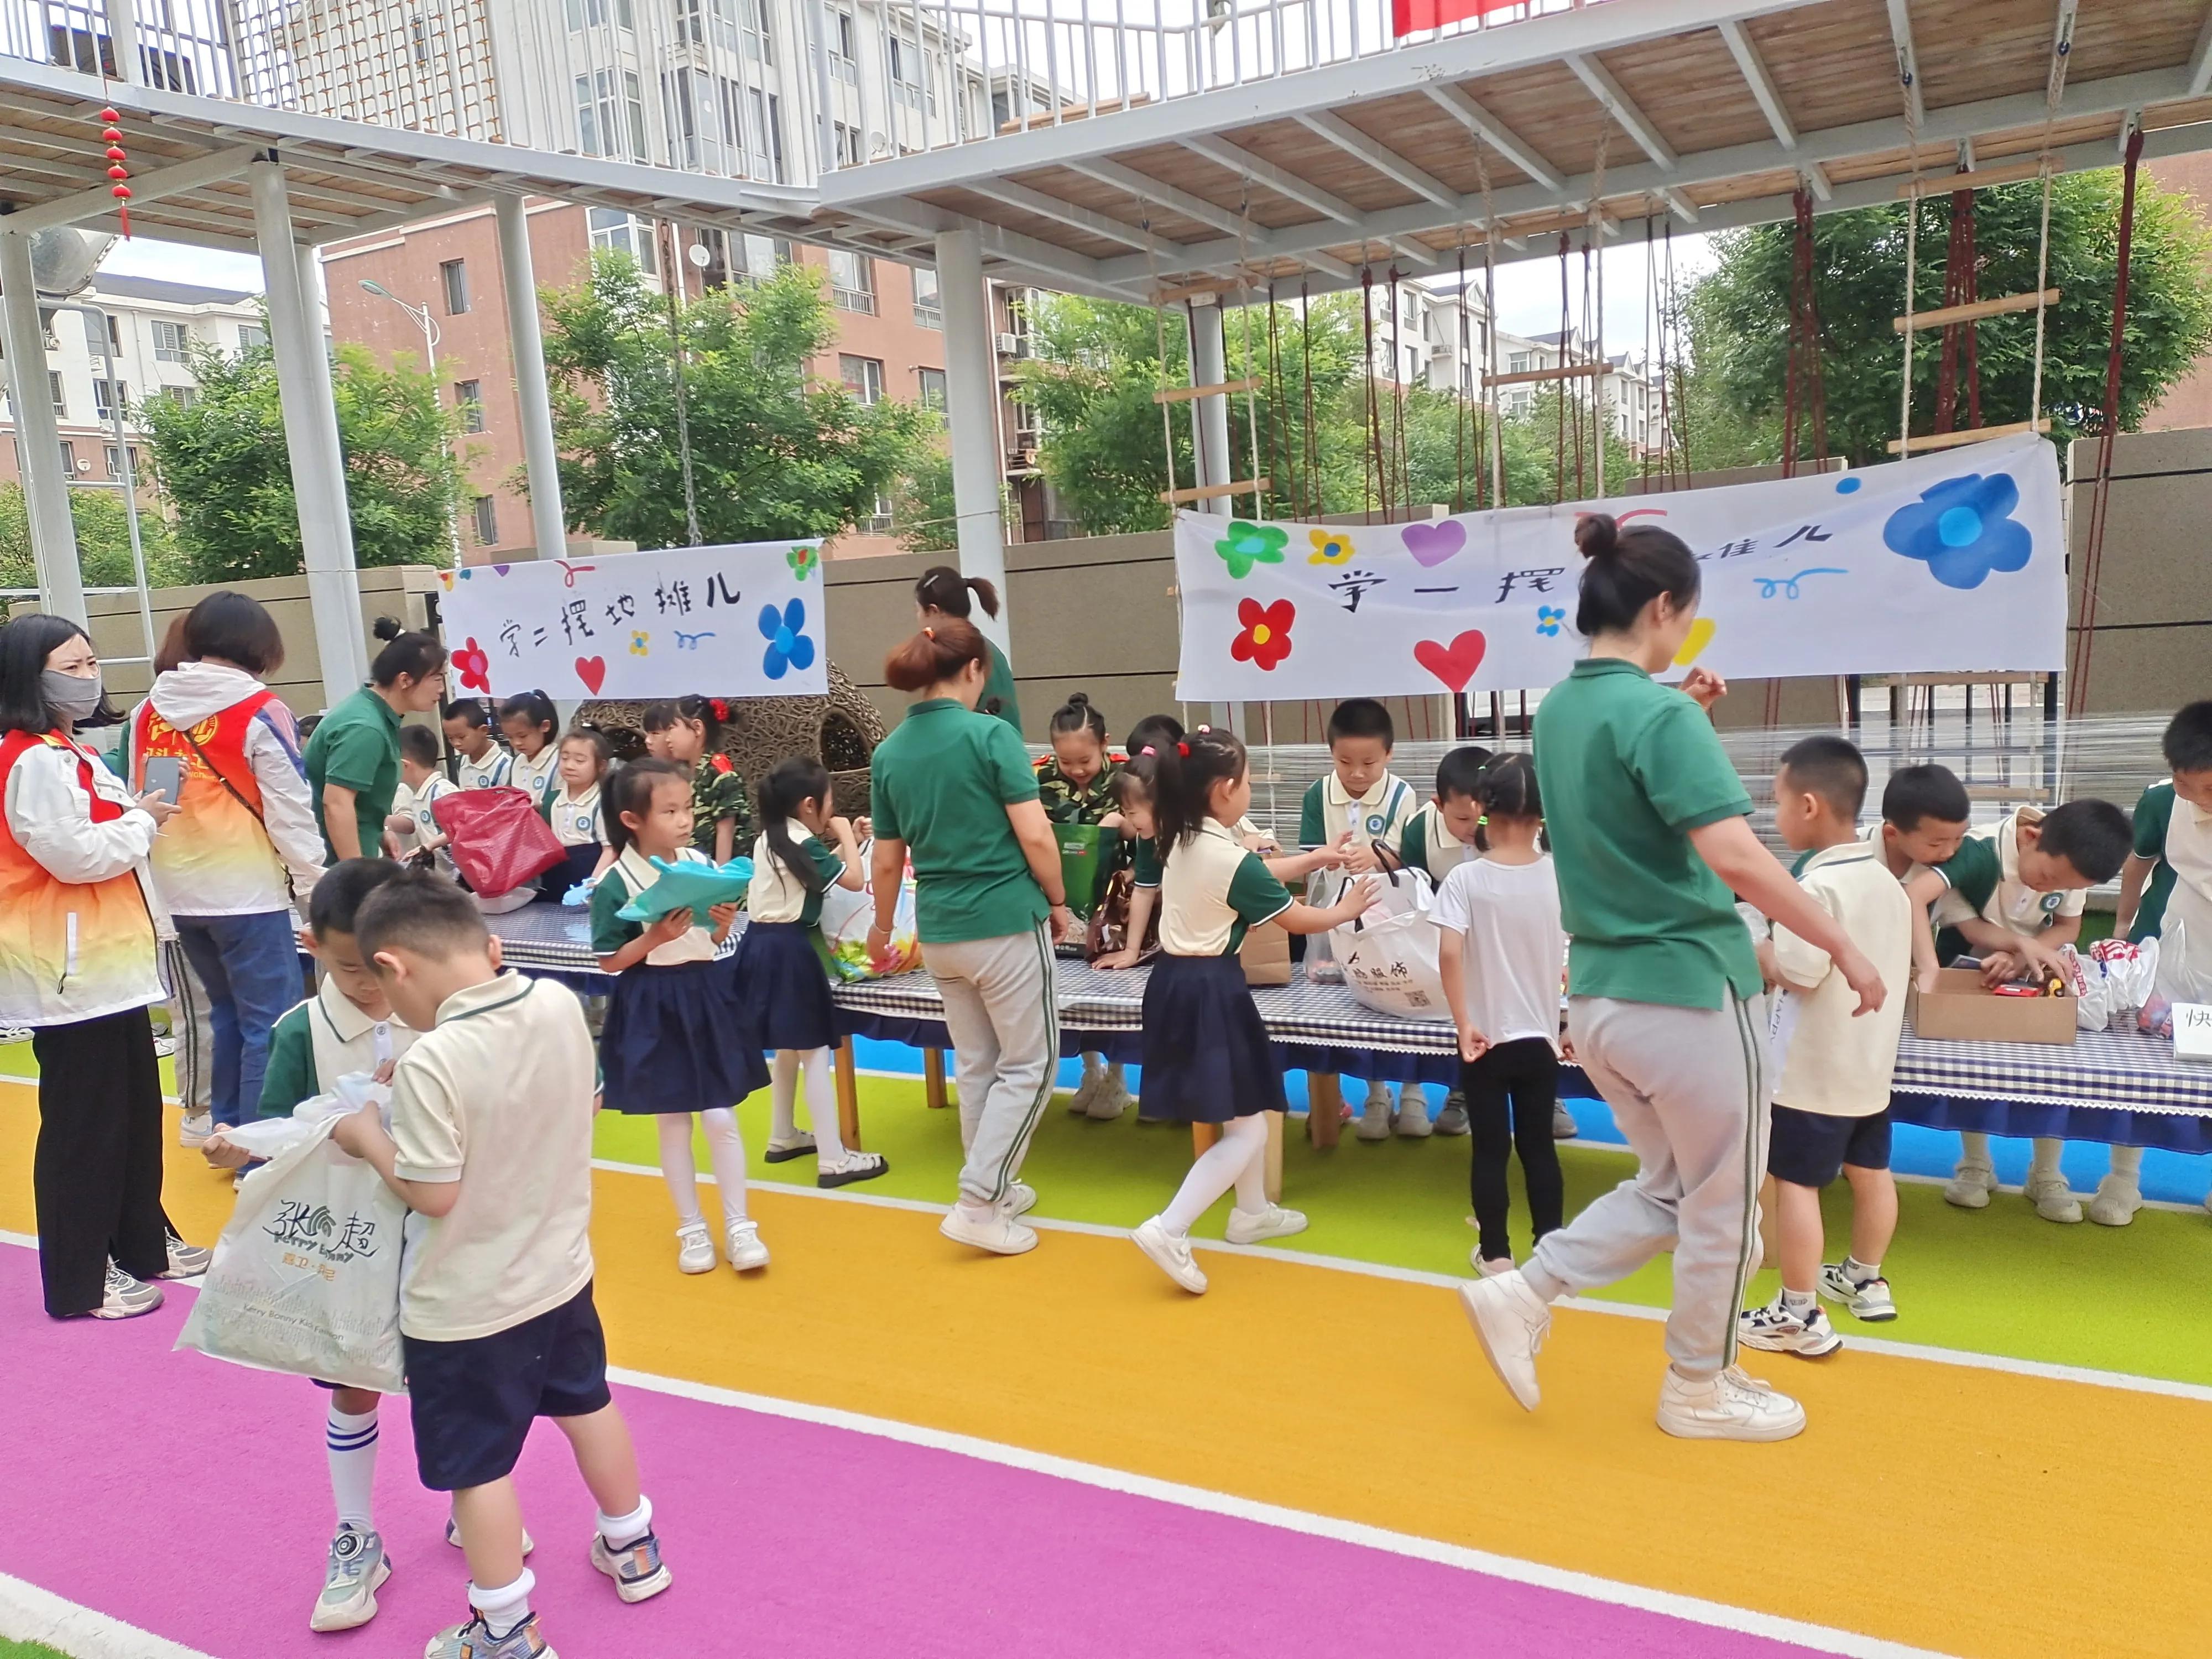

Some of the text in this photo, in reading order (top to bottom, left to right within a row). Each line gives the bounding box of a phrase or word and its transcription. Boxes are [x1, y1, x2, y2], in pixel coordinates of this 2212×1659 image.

[1328, 524, 1833, 613] 学一摆摊儿
